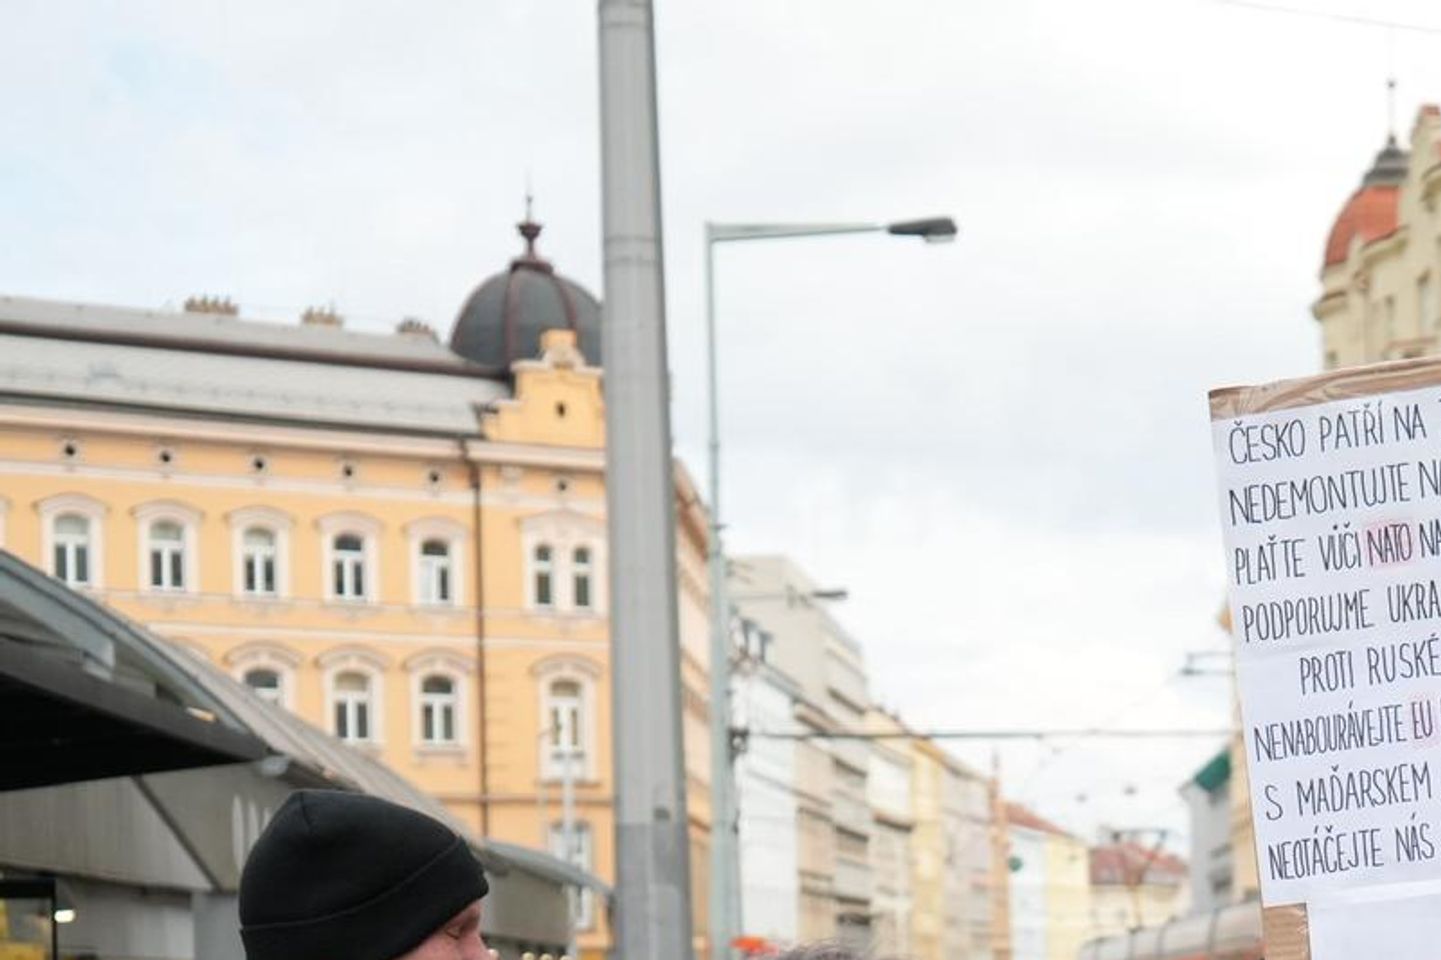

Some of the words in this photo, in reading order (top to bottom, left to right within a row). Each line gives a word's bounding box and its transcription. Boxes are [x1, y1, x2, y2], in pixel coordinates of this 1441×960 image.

[1229, 419, 1305, 464] ČESKO
[1319, 401, 1384, 452] PATŘÍ
[1393, 404, 1427, 442] NA
[1229, 462, 1410, 530] NEDEMONTUJTE
[1235, 534, 1306, 585] PLAŤTE
[1318, 521, 1362, 571] VŮČI
[1366, 523, 1413, 566] NATO
[1242, 589, 1374, 643] PODPORUJME
[1300, 651, 1354, 696] PROTI
[1254, 701, 1407, 762] NENABOURÁVEJTE
[1411, 700, 1433, 739] EU
[1265, 785, 1283, 821] S
[1296, 762, 1431, 820] MAĎARSKEM
[1268, 825, 1384, 880] NEOTÁČEJTE
[1395, 812, 1435, 862] NÁS
